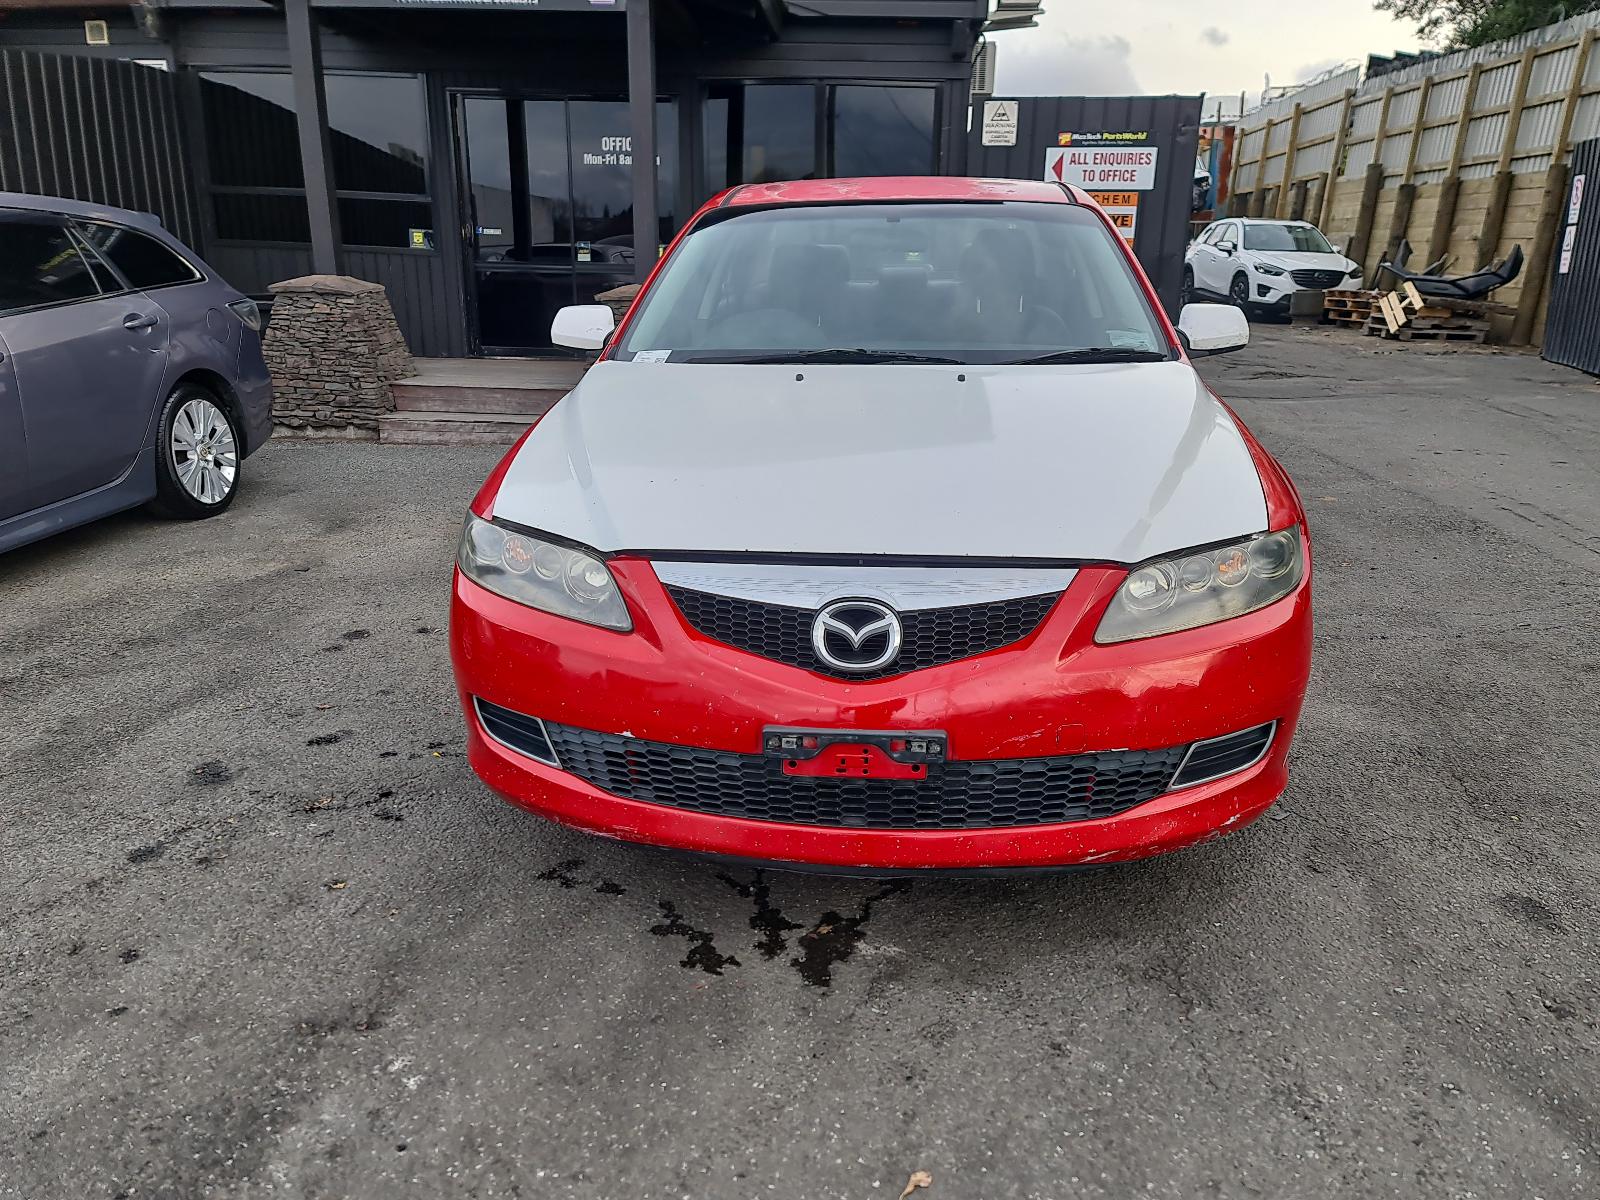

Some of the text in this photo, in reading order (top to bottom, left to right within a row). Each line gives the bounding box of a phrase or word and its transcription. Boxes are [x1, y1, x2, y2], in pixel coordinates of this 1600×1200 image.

[601, 136, 632, 152] OFFIC
[583, 153, 617, 165] Mon-Fri
[1069, 152, 1152, 167] ALL ENQUIRIES
[1082, 169, 1137, 183] TO OFFICE
[1110, 215, 1130, 227] YE
